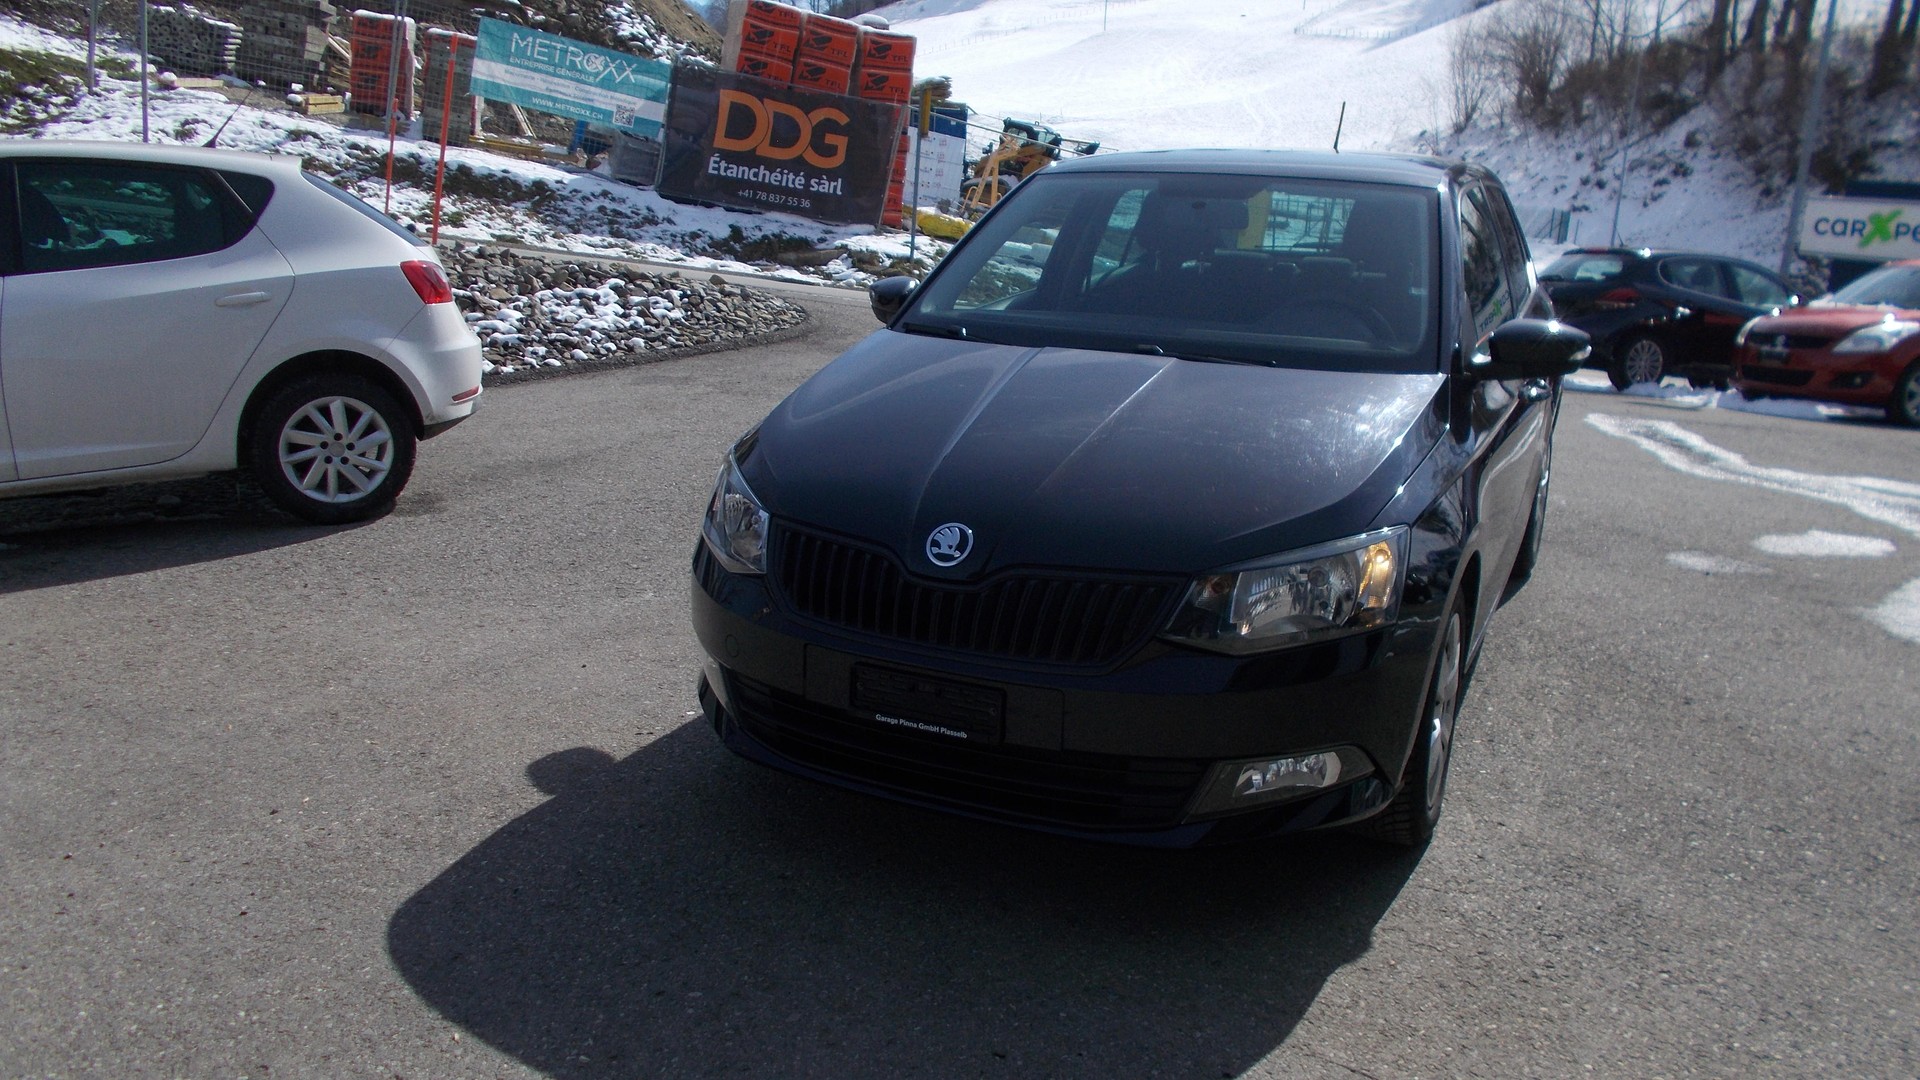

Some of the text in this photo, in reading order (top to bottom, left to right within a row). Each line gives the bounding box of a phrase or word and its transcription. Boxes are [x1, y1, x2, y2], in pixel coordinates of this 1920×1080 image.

[510, 57, 555, 73] ENTREPRISE
[511, 32, 637, 83] METROXX
[532, 97, 604, 120] WWW.METROXX.CH
[713, 89, 850, 169] DDG
[708, 153, 842, 195] Étanchéité sàrl
[738, 189, 811, 208] +41 78 837 55 36
[875, 714, 899, 725] Garage
[899, 718, 918, 728] Pinna
[918, 722, 940, 733] GmbH
